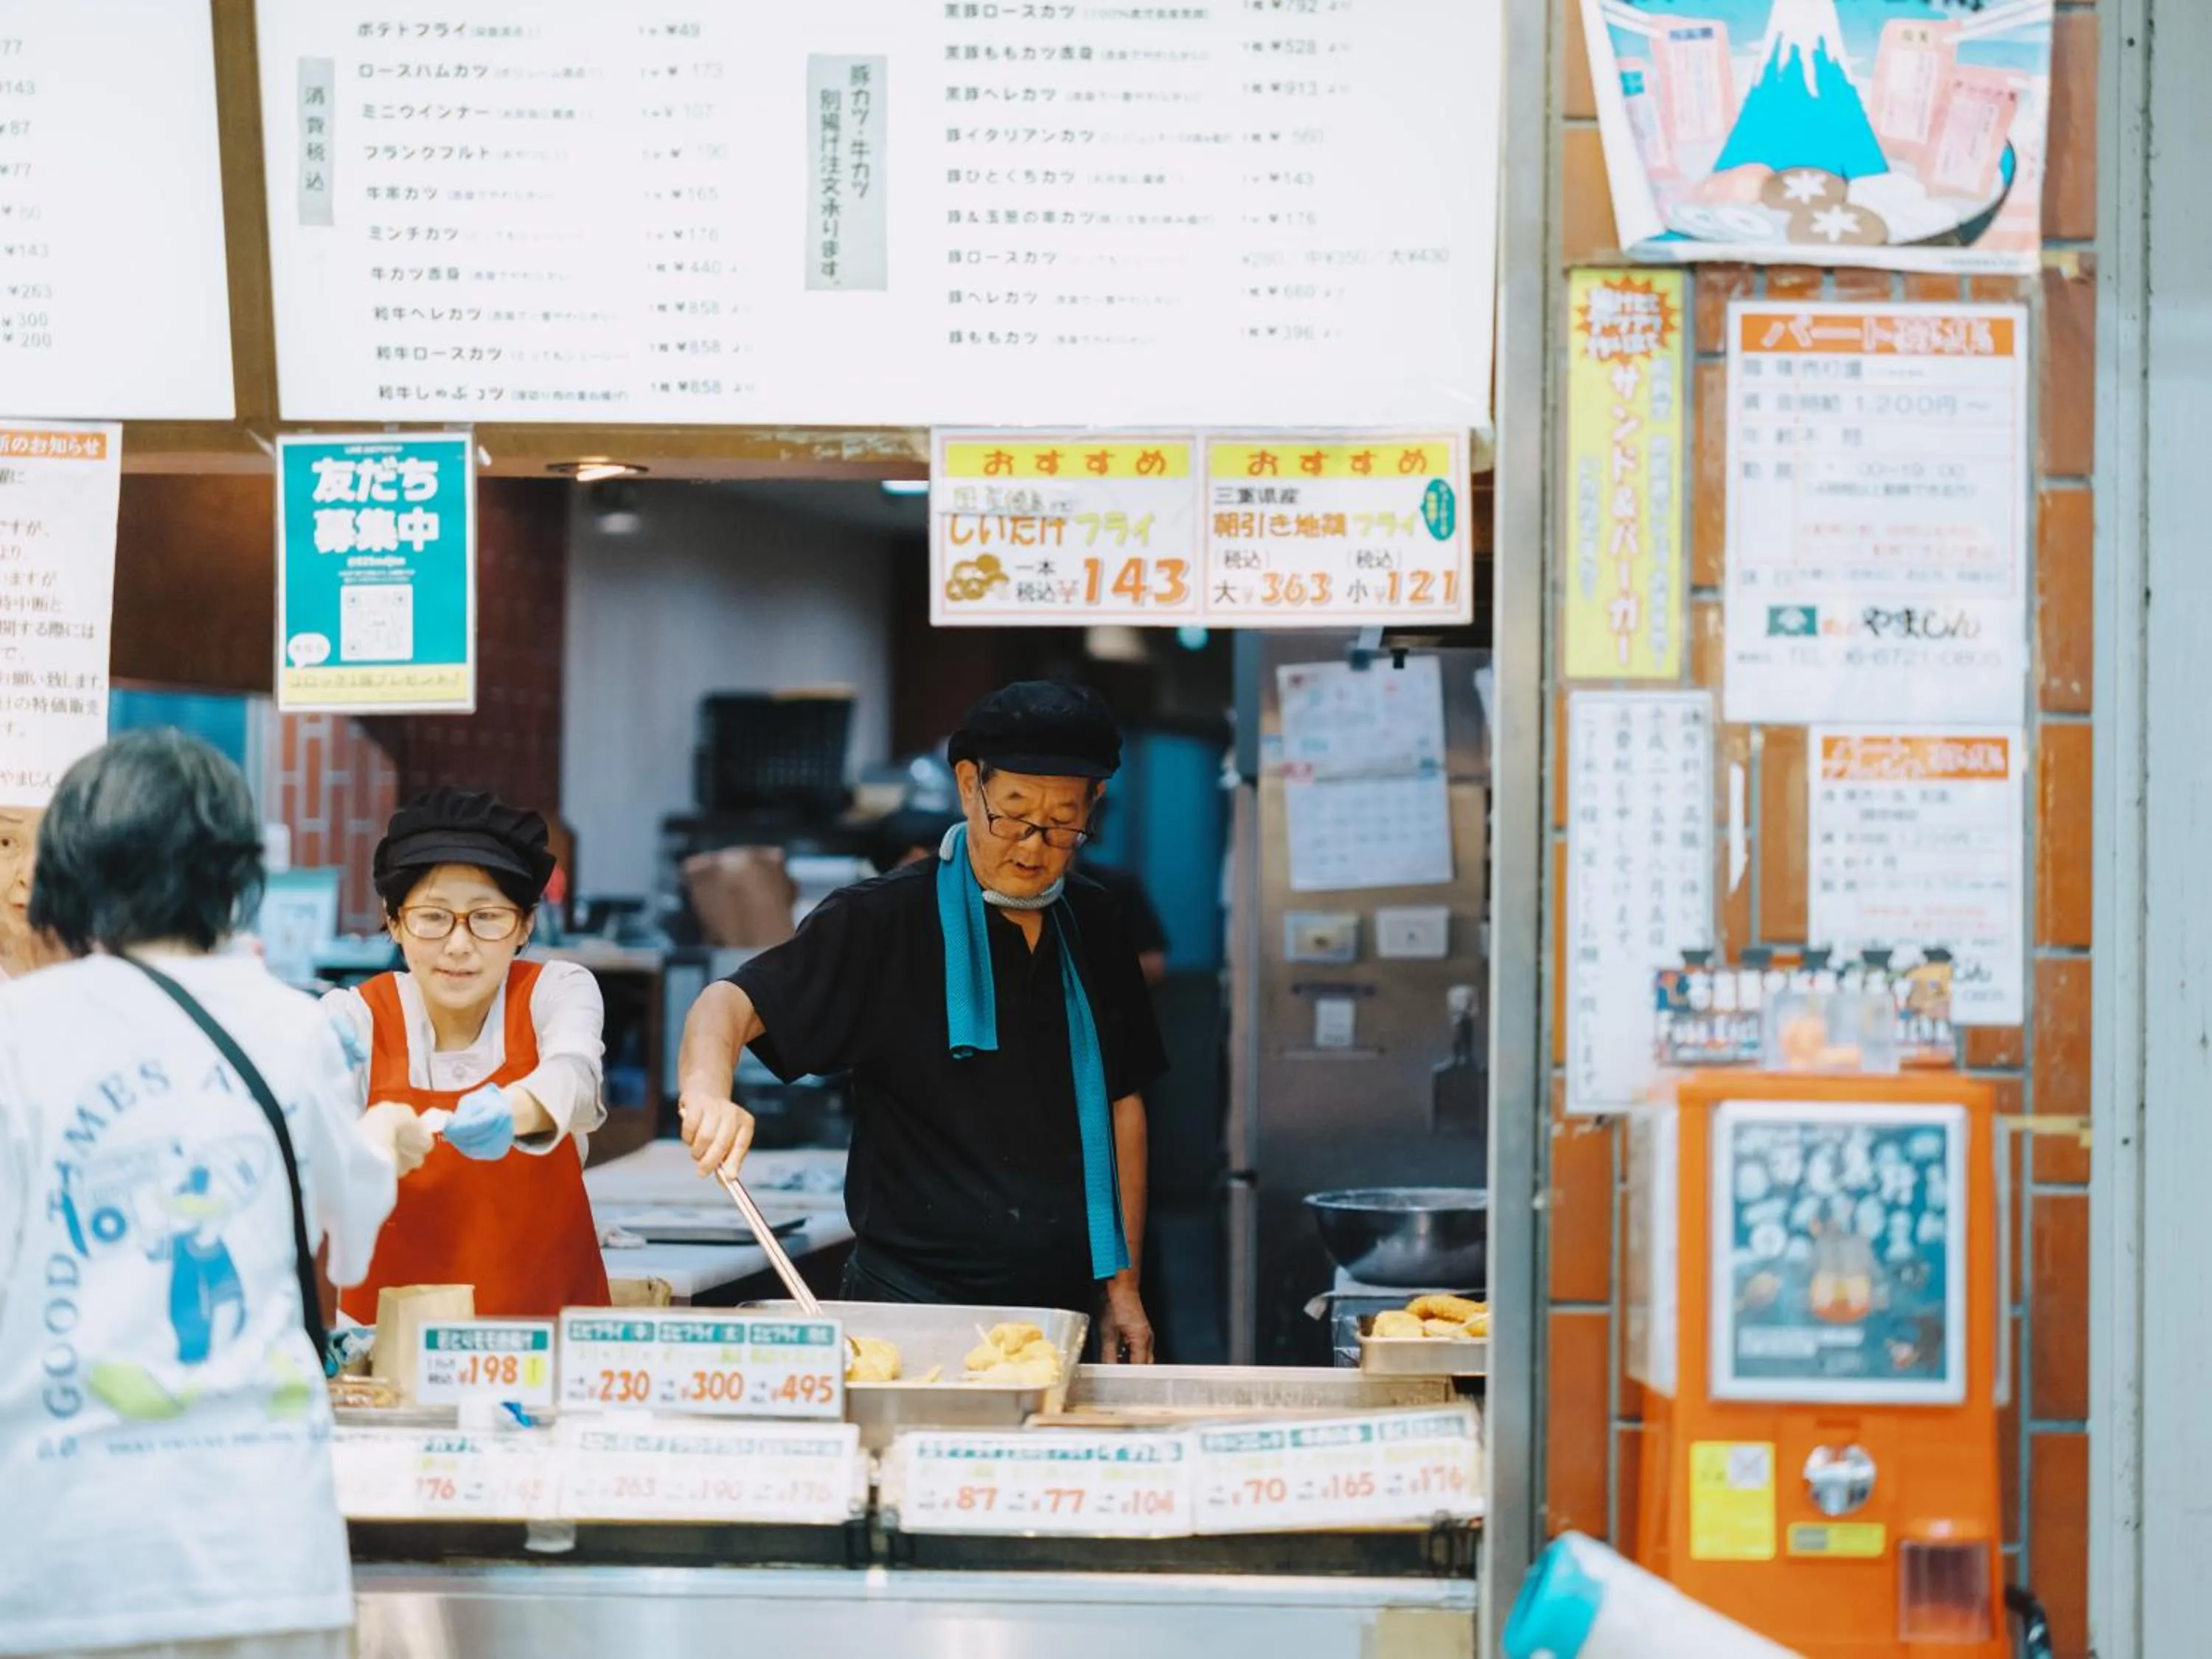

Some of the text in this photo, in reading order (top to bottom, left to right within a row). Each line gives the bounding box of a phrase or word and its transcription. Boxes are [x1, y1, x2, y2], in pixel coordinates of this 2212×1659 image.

[357, 22, 467, 38] ポテトフライ
[358, 63, 489, 80] ロースハムカツ
[362, 103, 491, 119] ミニウインナー
[304, 86, 327, 193] 消費税込
[364, 145, 490, 161] フランクフルト
[369, 225, 459, 242] ミンチカツ
[376, 345, 503, 362] 和牛ロースカツ
[983, 449, 1167, 476] おすすめ
[1246, 448, 1428, 476] おすすめ
[311, 456, 439, 504] 友だち
[1213, 487, 1301, 505] 三重県産
[313, 506, 440, 554] 募集中
[1074, 510, 1156, 547] フライ
[1213, 510, 1420, 538] 朝引き地鶏 フライ
[1015, 557, 1056, 575] 一本
[1016, 580, 1056, 603] 税込
[1214, 580, 1238, 604] 大
[1346, 579, 1368, 604] 小
[1862, 605, 1982, 640] やまじん
